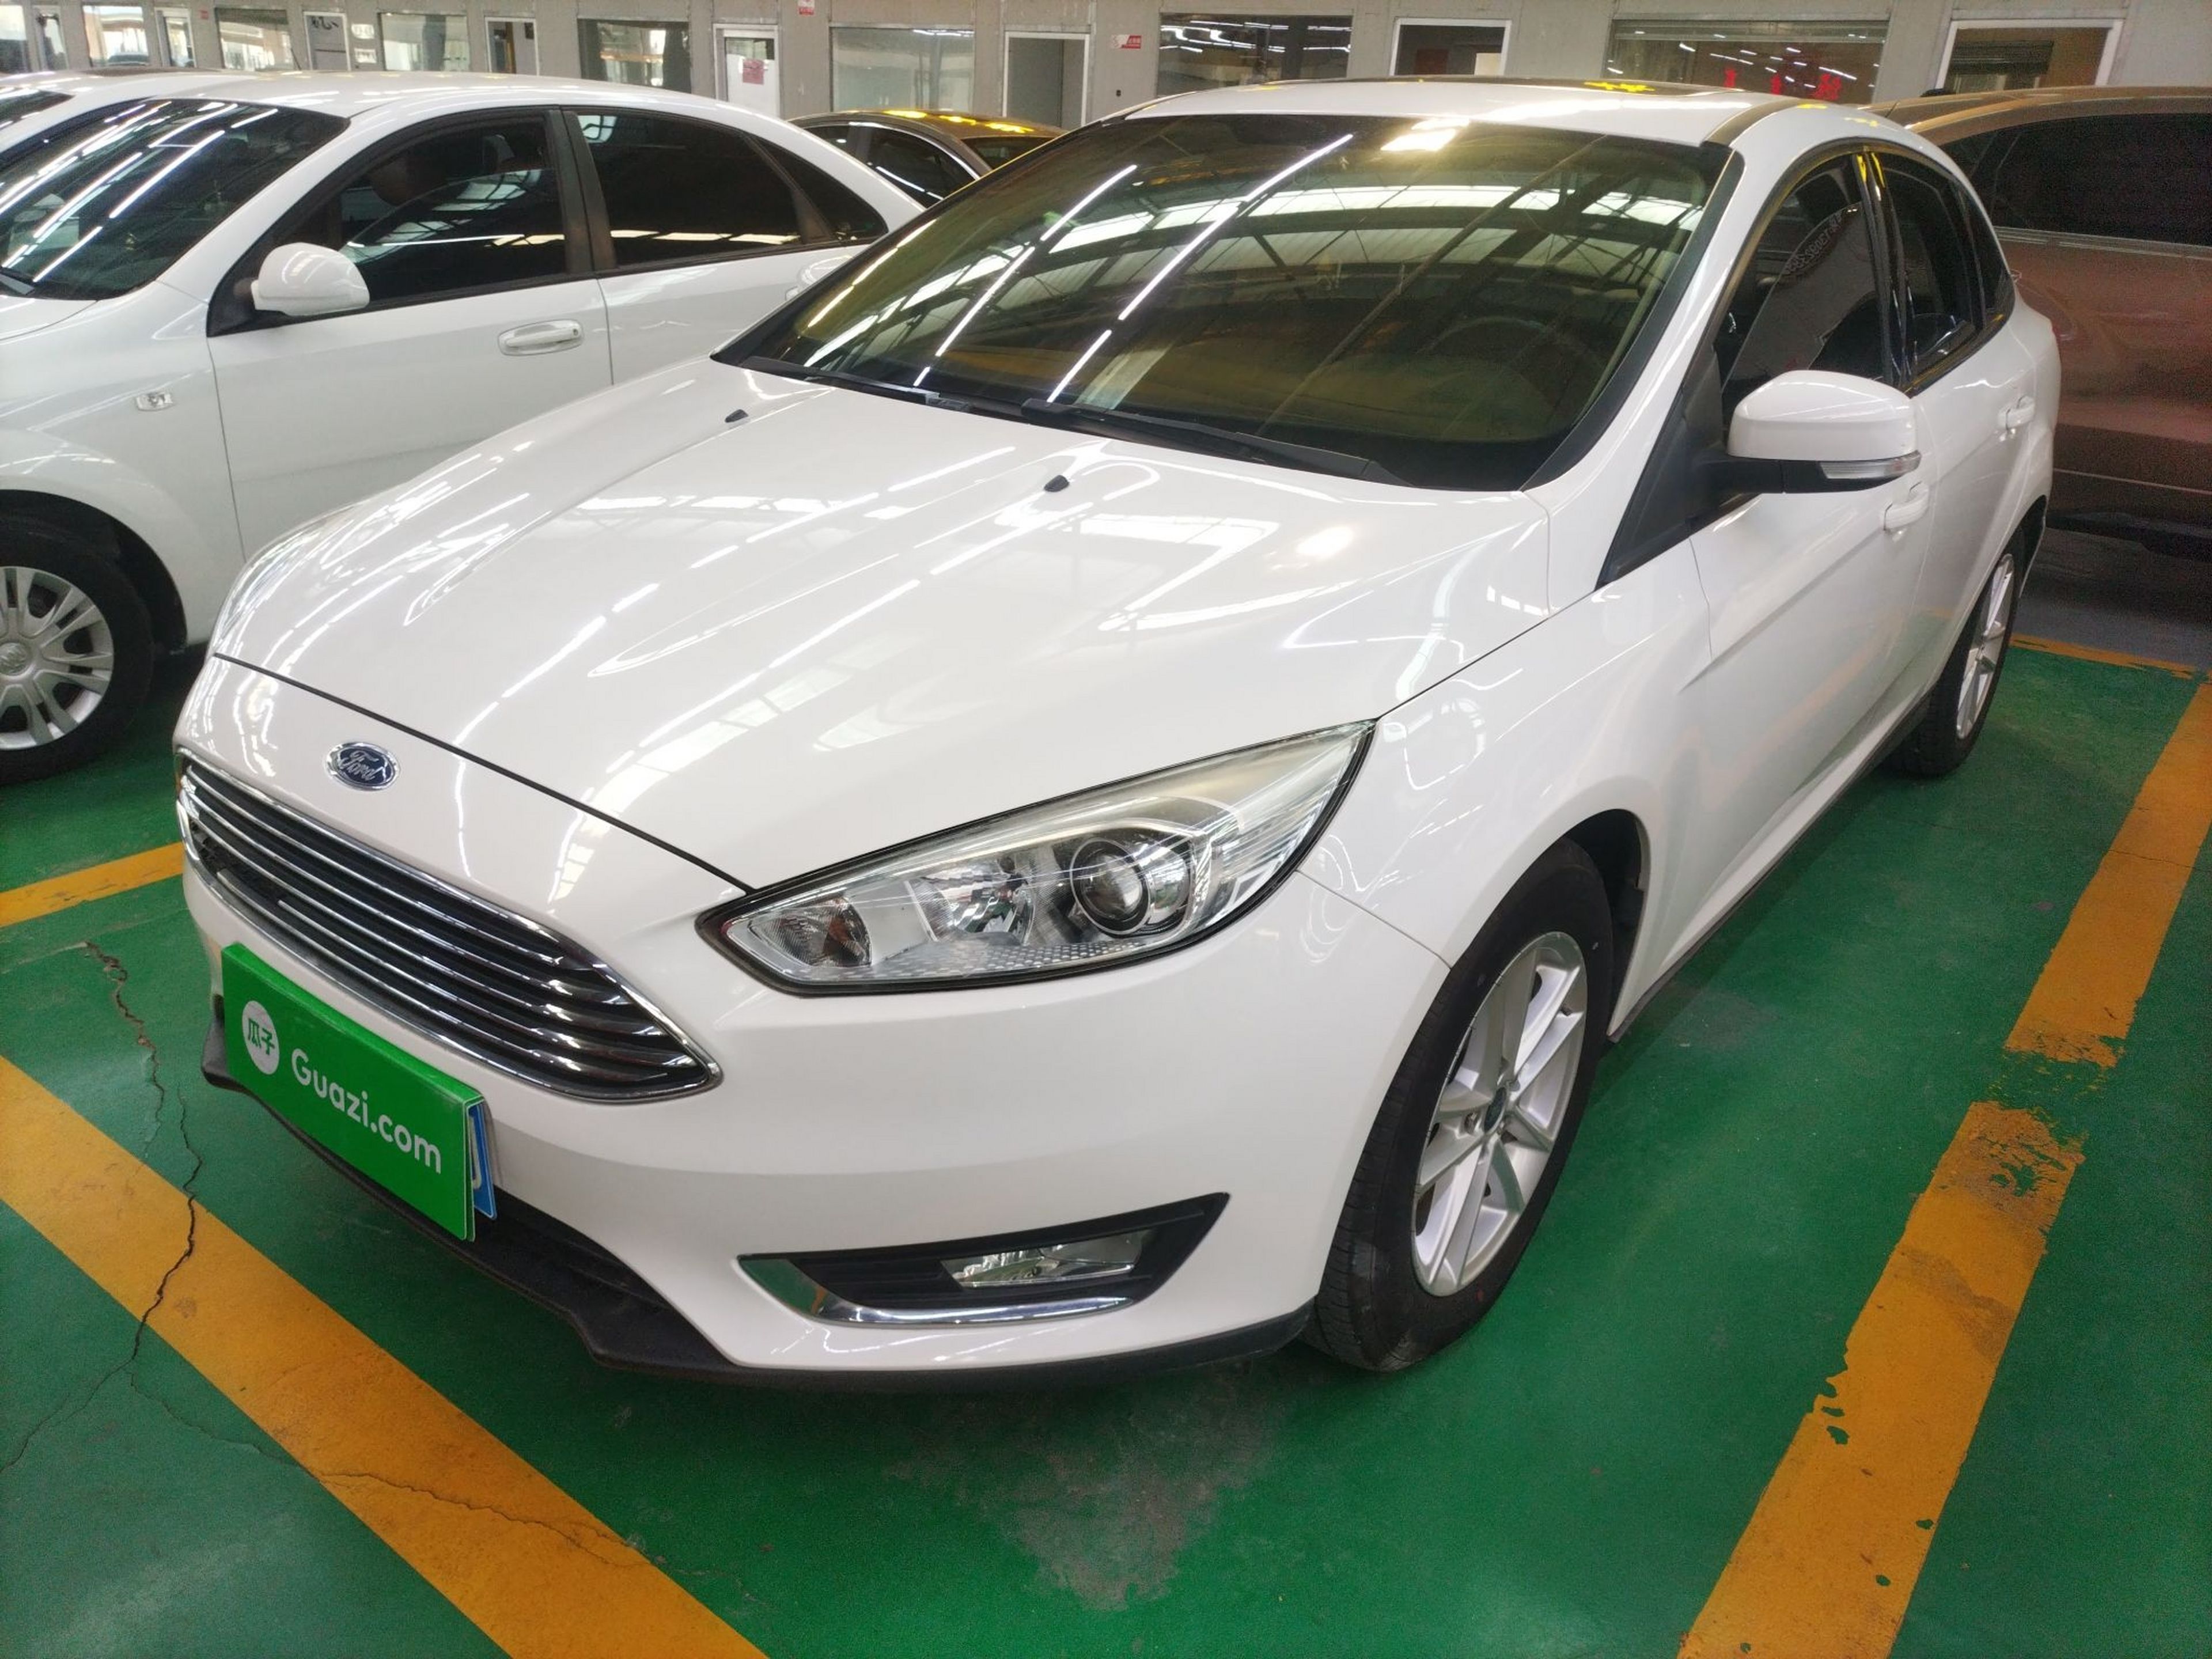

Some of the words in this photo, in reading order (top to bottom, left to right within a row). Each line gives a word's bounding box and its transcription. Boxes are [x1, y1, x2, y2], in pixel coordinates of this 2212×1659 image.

[338, 750, 385, 781] Ford
[247, 1018, 275, 1056] 瓜子
[291, 1048, 442, 1174] Guazi.com
